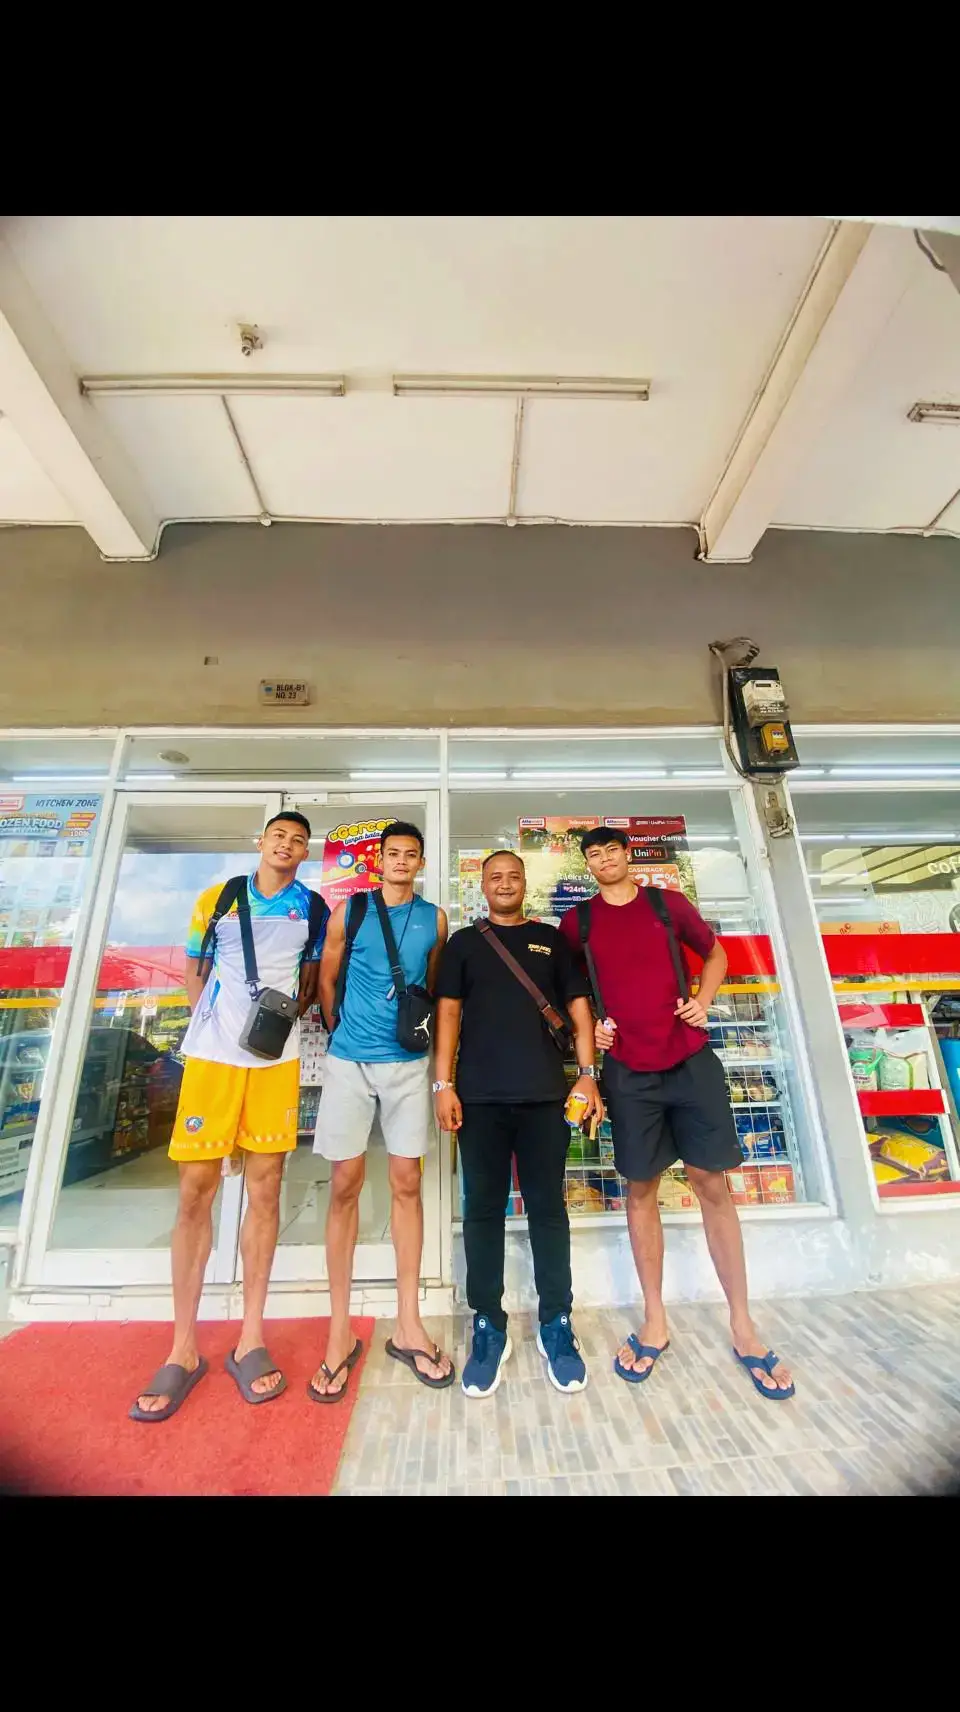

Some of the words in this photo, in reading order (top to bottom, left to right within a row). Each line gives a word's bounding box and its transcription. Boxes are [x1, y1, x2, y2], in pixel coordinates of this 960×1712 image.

[36, 799, 73, 807] KITCHEN
[75, 799, 99, 807] ZONE
[32, 819, 62, 829] FOOD
[660, 834, 682, 842] Game
[634, 849, 662, 857] UniPin
